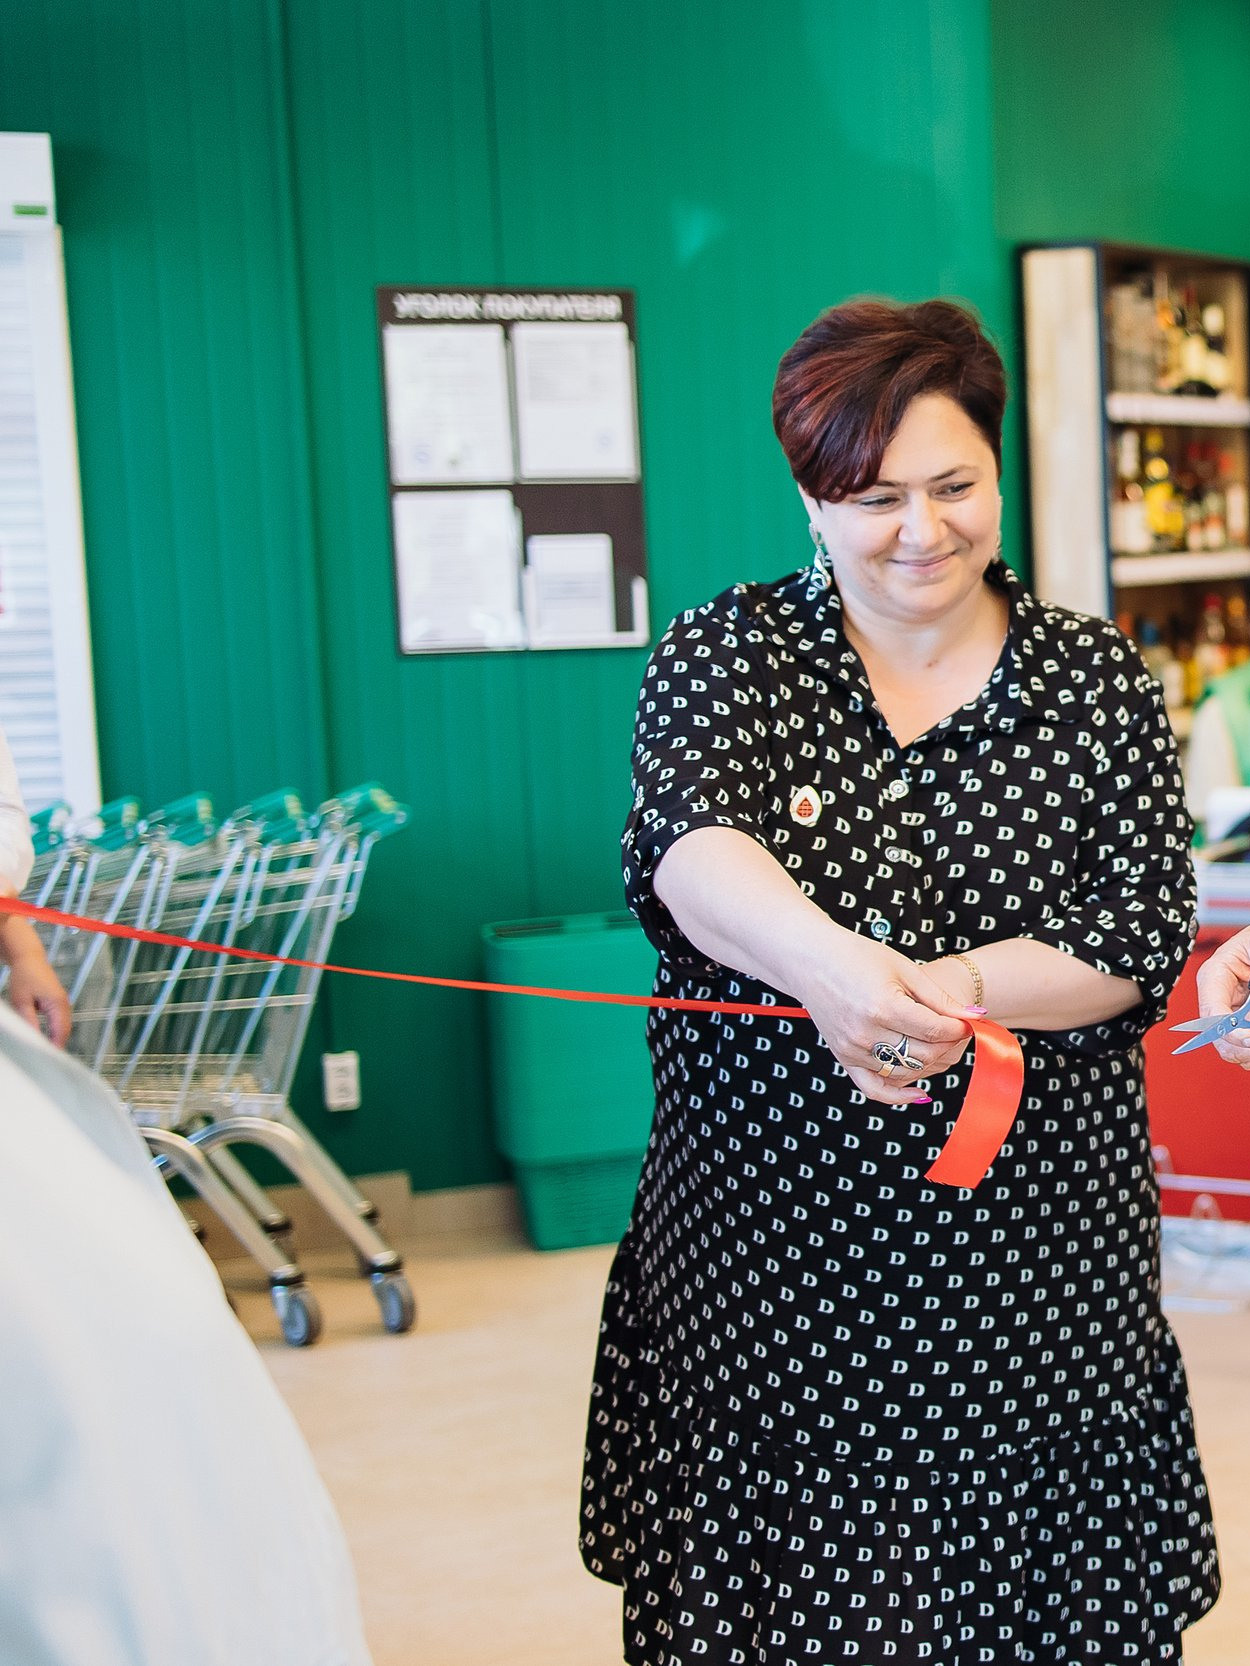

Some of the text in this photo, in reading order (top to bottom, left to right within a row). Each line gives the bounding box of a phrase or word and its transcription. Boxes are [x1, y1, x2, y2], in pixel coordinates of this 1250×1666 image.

[821, 628, 837, 643] D
[732, 657, 750, 673] D
[691, 679, 707, 692] D
[798, 674, 814, 688] D
[829, 708, 843, 724] D
[1037, 727, 1054, 741] D
[1076, 732, 1091, 746] D
[825, 746, 840, 763] D
[942, 748, 957, 762] D
[989, 759, 1006, 775] D
[1029, 767, 1046, 781] D
[920, 769, 936, 783] D
[1068, 773, 1084, 789] D
[841, 777, 855, 794] D
[964, 778, 982, 792] D
[1004, 785, 1022, 799] D
[1044, 791, 1061, 807] D
[980, 802, 997, 817] D
[835, 817, 850, 834] D
[1059, 817, 1077, 832] D
[773, 828, 789, 844] D
[882, 824, 897, 840] D
[997, 826, 1015, 840] D
[812, 837, 827, 850] D
[1036, 834, 1052, 849] D
[850, 847, 867, 863] D
[972, 844, 990, 858] D
[824, 861, 842, 878] D
[876, 863, 893, 878] D
[948, 864, 965, 878] D
[988, 868, 1006, 883] D
[1028, 876, 1044, 892] D
[839, 891, 856, 908] D
[963, 889, 980, 904] D
[1004, 895, 1021, 910] D
[920, 920, 933, 933] D
[978, 916, 996, 930] D
[955, 936, 970, 950] D
[1083, 931, 1103, 946] D
[778, 1020, 792, 1035] D
[698, 1054, 712, 1067] D
[794, 1048, 809, 1063] D
[751, 1080, 766, 1094] D
[811, 1078, 825, 1092] D
[946, 1075, 959, 1088] D
[826, 1106, 842, 1121] D
[748, 1123, 761, 1136] D
[867, 1116, 883, 1130] D
[909, 1123, 925, 1137] D
[783, 1136, 797, 1150] D
[843, 1134, 859, 1148] D
[885, 1142, 901, 1155] D
[902, 1166, 918, 1179] D
[778, 1178, 792, 1192] D
[837, 1177, 853, 1191] D
[878, 1186, 894, 1199] D
[793, 1206, 807, 1220] D
[831, 1218, 847, 1232] D
[872, 1228, 888, 1241] D
[913, 1232, 929, 1245] D
[848, 1245, 864, 1258] D
[890, 1252, 906, 1265] D
[766, 1258, 779, 1273] D
[802, 1273, 817, 1286] D
[947, 1275, 963, 1288] D
[986, 1273, 1000, 1286] D
[1020, 1269, 1033, 1282] D
[842, 1284, 857, 1298] D
[882, 1293, 899, 1306] D
[760, 1300, 773, 1315] D
[795, 1315, 810, 1330] D
[859, 1310, 875, 1324] D
[899, 1317, 916, 1330] D
[980, 1316, 994, 1329] D
[1015, 1312, 1028, 1325] D
[834, 1326, 850, 1341] D
[875, 1336, 891, 1349] D
[957, 1339, 973, 1352] D
[811, 1343, 826, 1357] D
[850, 1353, 867, 1367] D
[891, 1360, 908, 1373] D
[767, 1372, 780, 1387] D
[826, 1370, 842, 1385] D
[867, 1379, 883, 1393] D
[909, 1383, 925, 1396] D
[950, 1383, 966, 1396] D
[988, 1380, 1003, 1394] D
[803, 1387, 818, 1401] D
[843, 1397, 859, 1411] D
[884, 1404, 900, 1417] D
[760, 1414, 773, 1429] D
[1048, 1413, 1061, 1426] D
[1080, 1408, 1093, 1422] D
[859, 1423, 876, 1437] D
[981, 1425, 997, 1438] D
[1016, 1419, 1030, 1432] D
[796, 1430, 810, 1444] D
[901, 1427, 918, 1440] D
[943, 1427, 959, 1440] D
[707, 1447, 723, 1462] D
[834, 1441, 851, 1455] D
[875, 1448, 892, 1461] D
[816, 1468, 830, 1483] D
[773, 1480, 788, 1494] D
[895, 1476, 909, 1490] D
[694, 1492, 707, 1507] D
[830, 1495, 843, 1509] D
[913, 1498, 928, 1513] D
[988, 1492, 1002, 1505] D
[1107, 1495, 1120, 1508] D
[861, 1500, 877, 1514] D
[703, 1520, 719, 1534] D
[1144, 1522, 1157, 1535] D
[737, 1531, 751, 1544] D
[789, 1536, 804, 1551] D
[961, 1536, 975, 1550] D
[823, 1543, 837, 1557] D
[915, 1546, 929, 1561] D
[1087, 1557, 1101, 1570] D
[1149, 1562, 1162, 1575] D
[690, 1566, 705, 1580] D
[800, 1564, 815, 1579] D
[872, 1570, 885, 1584] D
[778, 1583, 792, 1598] D
[941, 1588, 954, 1602] D
[998, 1582, 1011, 1596] D
[703, 1592, 718, 1607] D
[814, 1591, 830, 1605] D
[849, 1594, 866, 1608] D
[741, 1603, 754, 1618] D
[1124, 1600, 1138, 1613] D
[1154, 1603, 1168, 1616] D
[679, 1611, 694, 1626] D
[716, 1620, 732, 1635] D
[960, 1626, 975, 1640] D
[999, 1626, 1012, 1639] D
[771, 1630, 786, 1645] D
[691, 1639, 707, 1654] D
[805, 1639, 821, 1653] D
[843, 1641, 859, 1655] D
[883, 1641, 896, 1655] D
[918, 1643, 932, 1657] D
[1087, 1640, 1100, 1653] D
[729, 1649, 745, 1664] D
[980, 1648, 994, 1661] D
